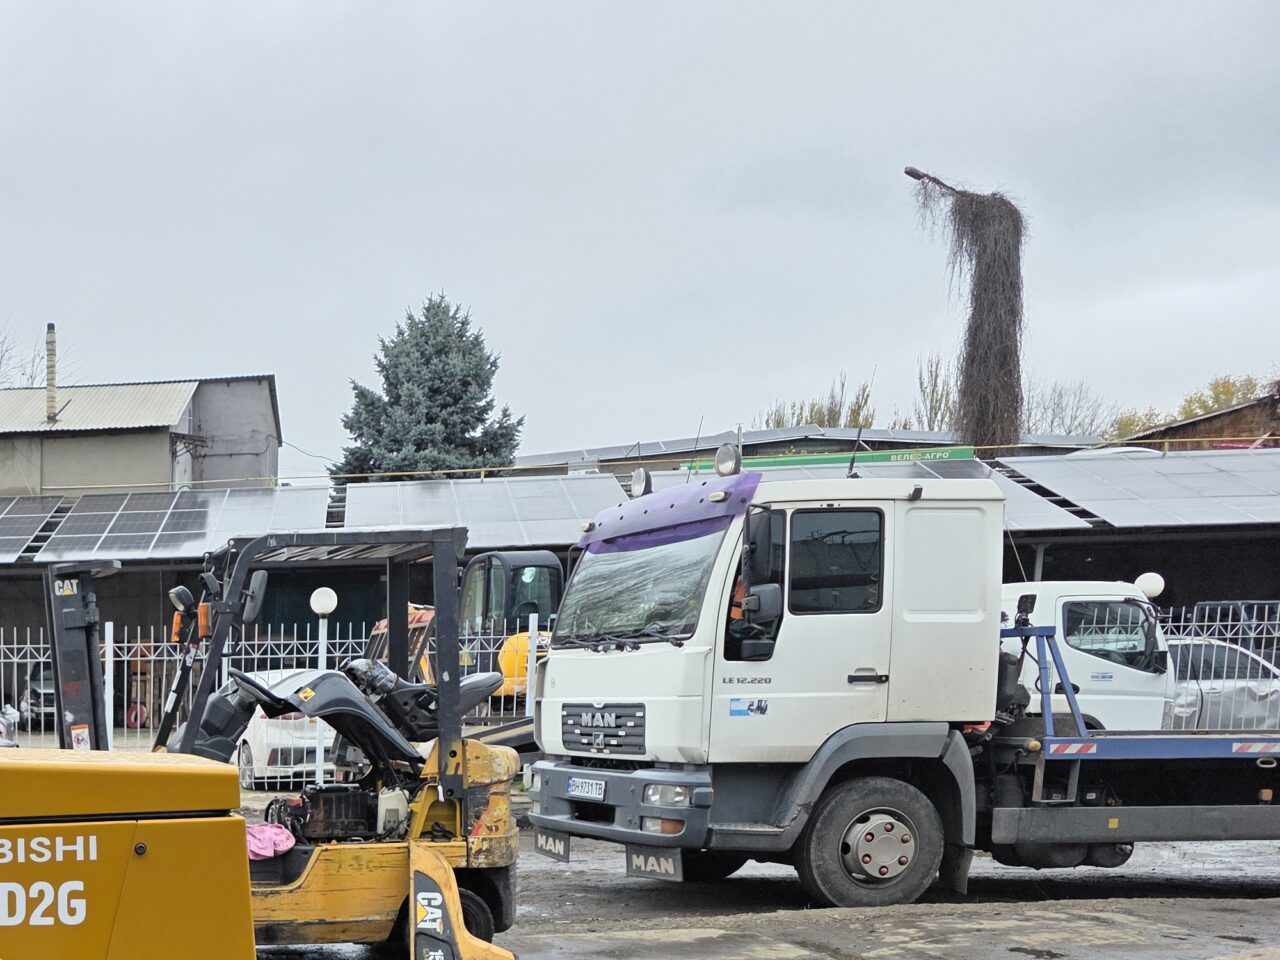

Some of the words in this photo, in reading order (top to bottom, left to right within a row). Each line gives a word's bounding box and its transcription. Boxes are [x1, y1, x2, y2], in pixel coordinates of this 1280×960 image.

[54, 579, 78, 596] CAT
[581, 712, 616, 727] MAN
[537, 833, 564, 856] MAN
[632, 854, 675, 875] MAN
[417, 892, 443, 934] CAT
